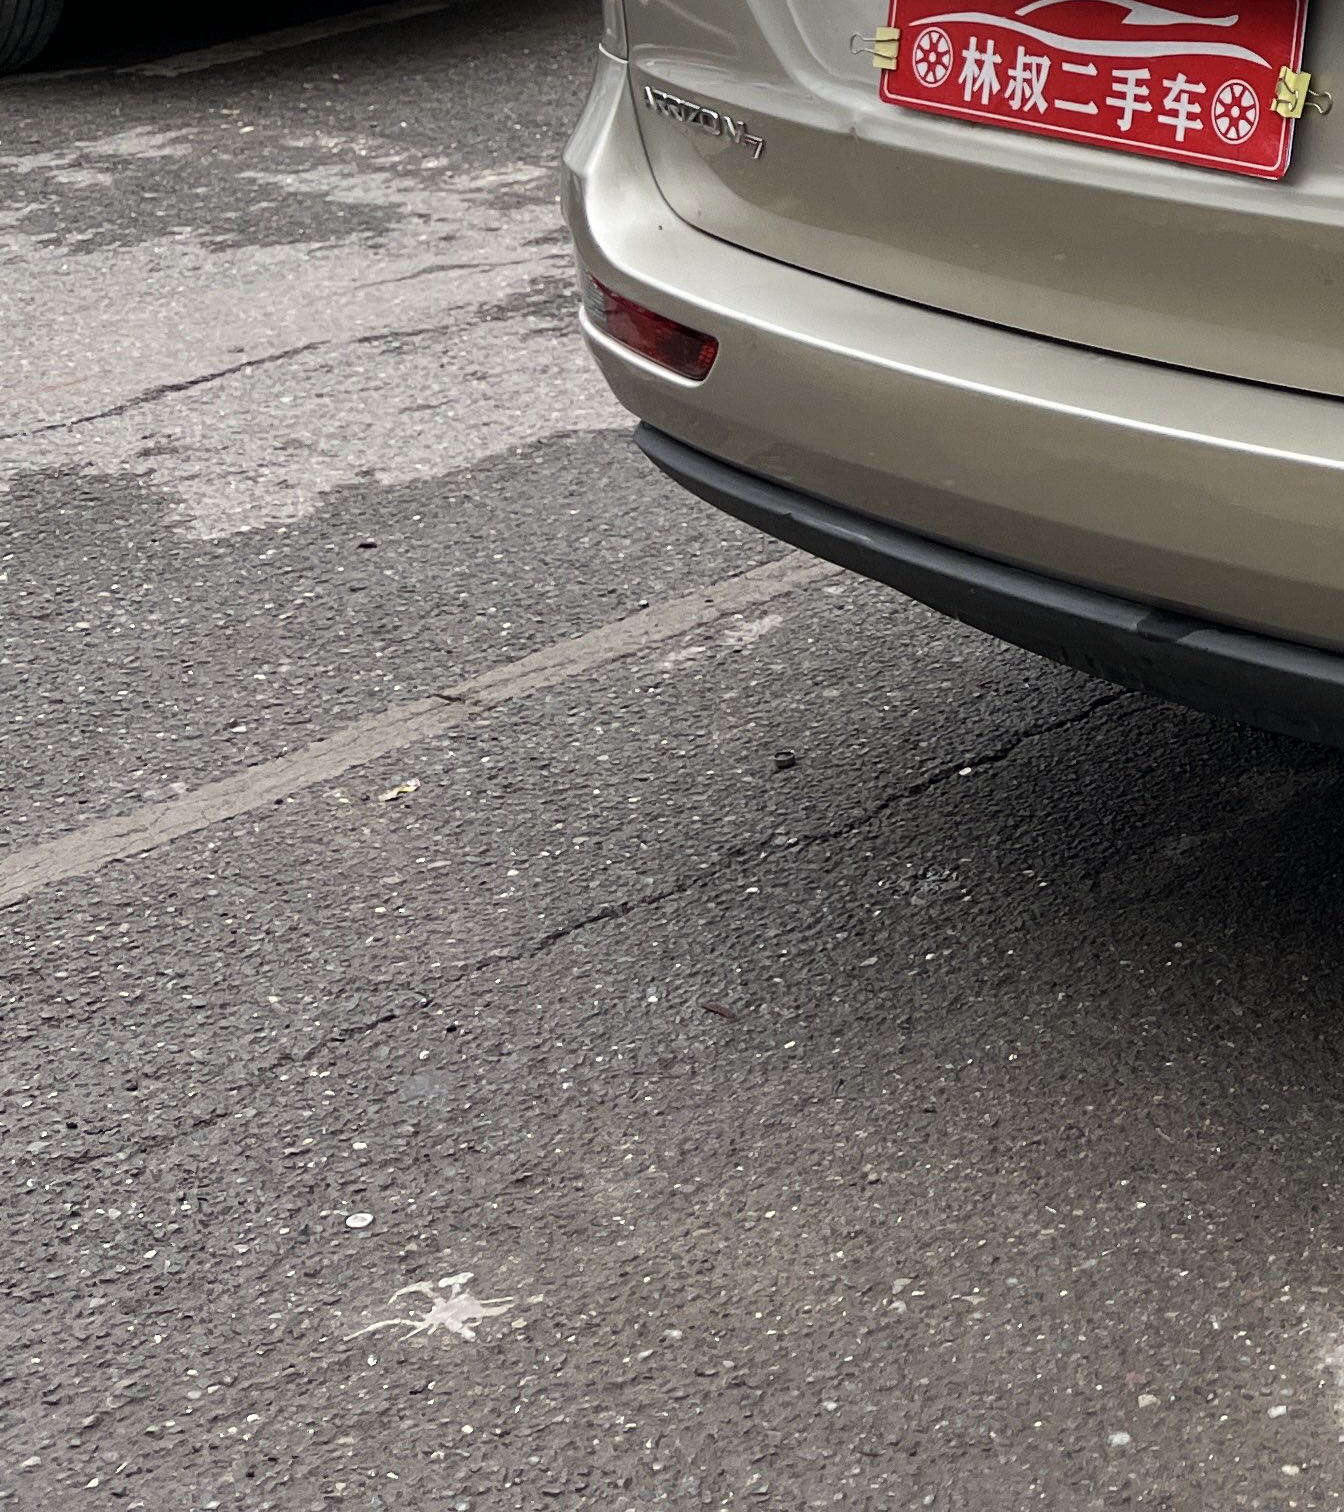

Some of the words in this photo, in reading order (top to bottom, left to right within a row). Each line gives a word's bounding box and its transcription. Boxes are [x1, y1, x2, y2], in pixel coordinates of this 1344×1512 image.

[958, 35, 1207, 143] 林叔二手车
